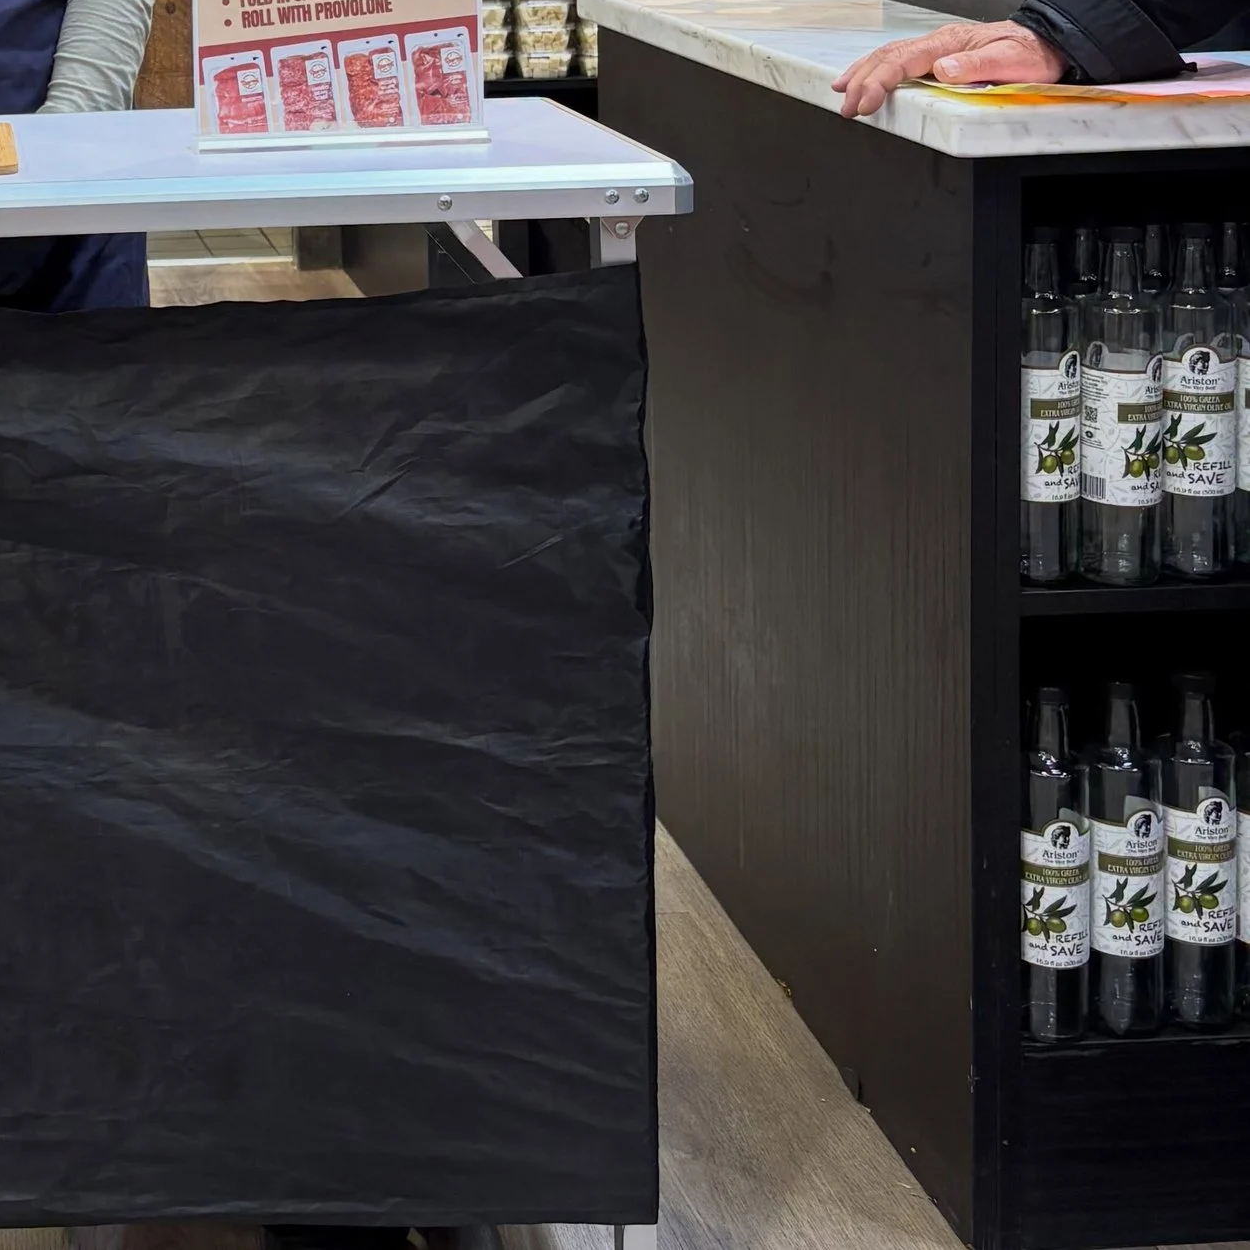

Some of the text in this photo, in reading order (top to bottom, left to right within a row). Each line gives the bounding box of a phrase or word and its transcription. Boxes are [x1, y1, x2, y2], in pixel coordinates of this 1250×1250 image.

[241, 8, 275, 29] ROLL
[277, 4, 312, 26] WITH
[1180, 376, 1217, 386] Ariston
[1193, 460, 1232, 471] REFILL
[1045, 479, 1062, 487] and
[1167, 470, 1225, 485] and SAVE
[1131, 483, 1148, 492] and
[1195, 826, 1229, 837] Ariston
[1125, 840, 1157, 850] Ariston
[1042, 850, 1078, 860] Ariston
[1181, 918, 1233, 932] and SAVE
[1112, 931, 1162, 946] and SAVE
[1028, 942, 1083, 957] and SAVE
